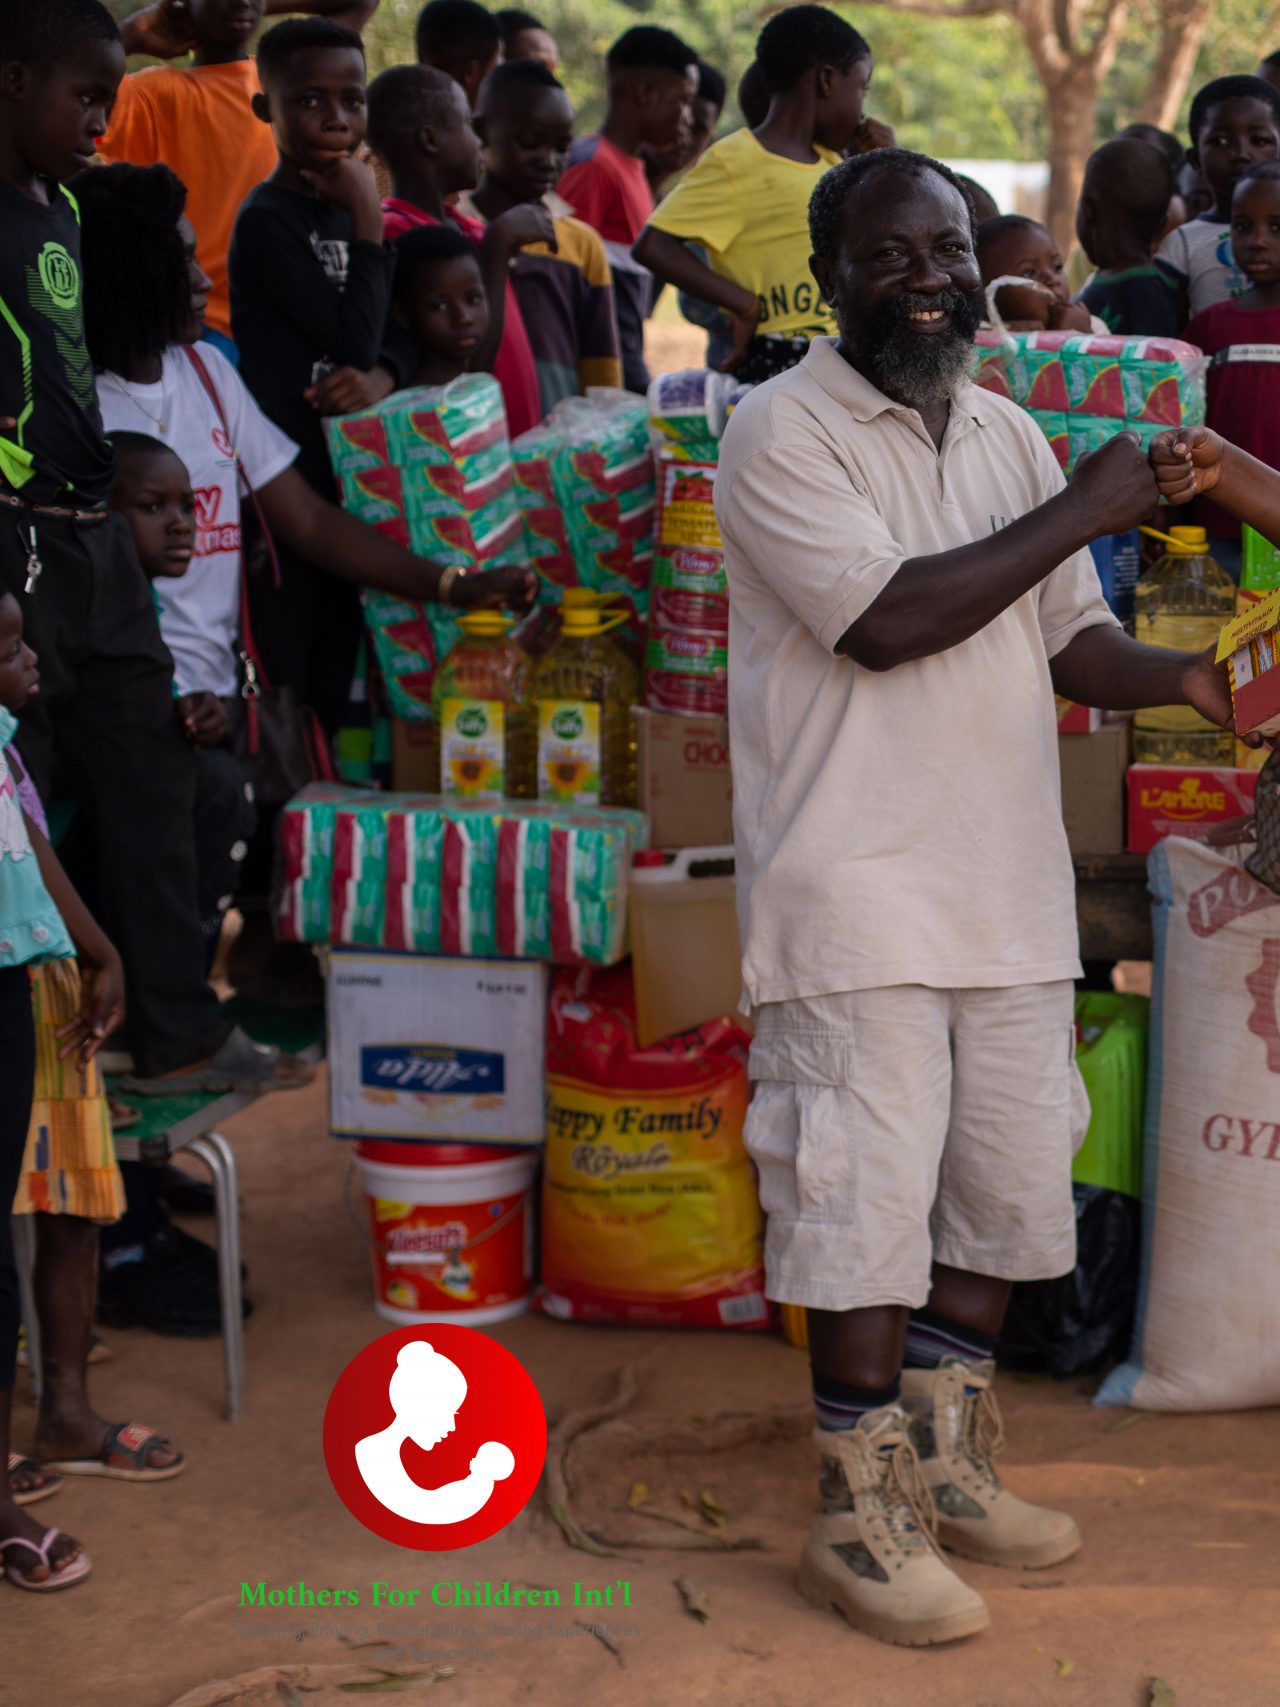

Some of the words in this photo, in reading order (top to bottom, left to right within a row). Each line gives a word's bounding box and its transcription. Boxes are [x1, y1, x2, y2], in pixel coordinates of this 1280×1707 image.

[1231, 605, 1274, 639] MULTIVITAMIN
[548, 1106, 606, 1142] appy
[614, 1098, 722, 1139] Family
